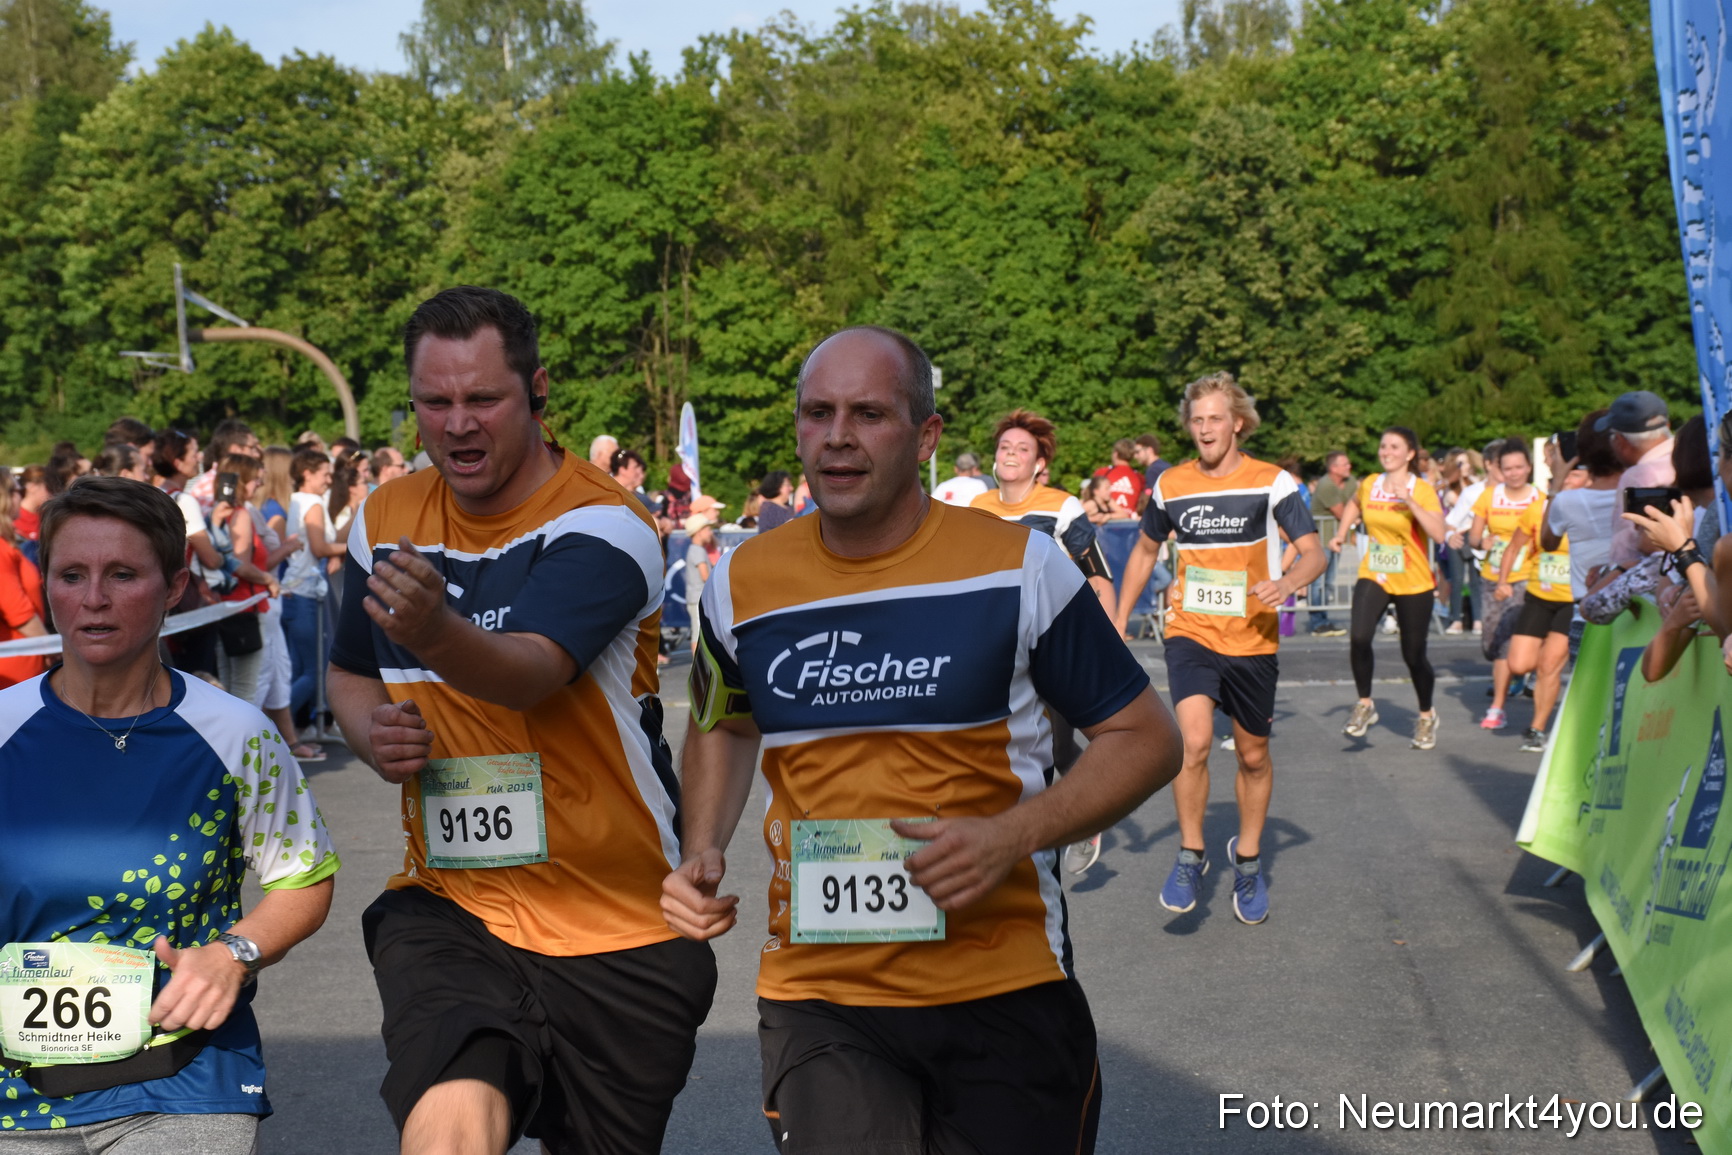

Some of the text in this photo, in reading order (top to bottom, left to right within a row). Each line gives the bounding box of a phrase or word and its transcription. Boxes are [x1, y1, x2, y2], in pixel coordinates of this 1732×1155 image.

[1190, 515, 1248, 529] Fischer
[1372, 554, 1398, 566] 1600
[1197, 588, 1232, 605] 9135
[797, 653, 951, 689] Fischer
[811, 683, 937, 706] AUTOMOBILE
[507, 782, 533, 793] 2019
[440, 805, 512, 843] 9136
[813, 842, 861, 855] firmenlauf
[822, 874, 909, 913] 9133
[13, 966, 75, 978] firmenlauf
[112, 974, 141, 984] 2019
[23, 986, 112, 1029] 266
[18, 1031, 121, 1042] Schmidtner Heike
[41, 1044, 79, 1052] Bionorica
